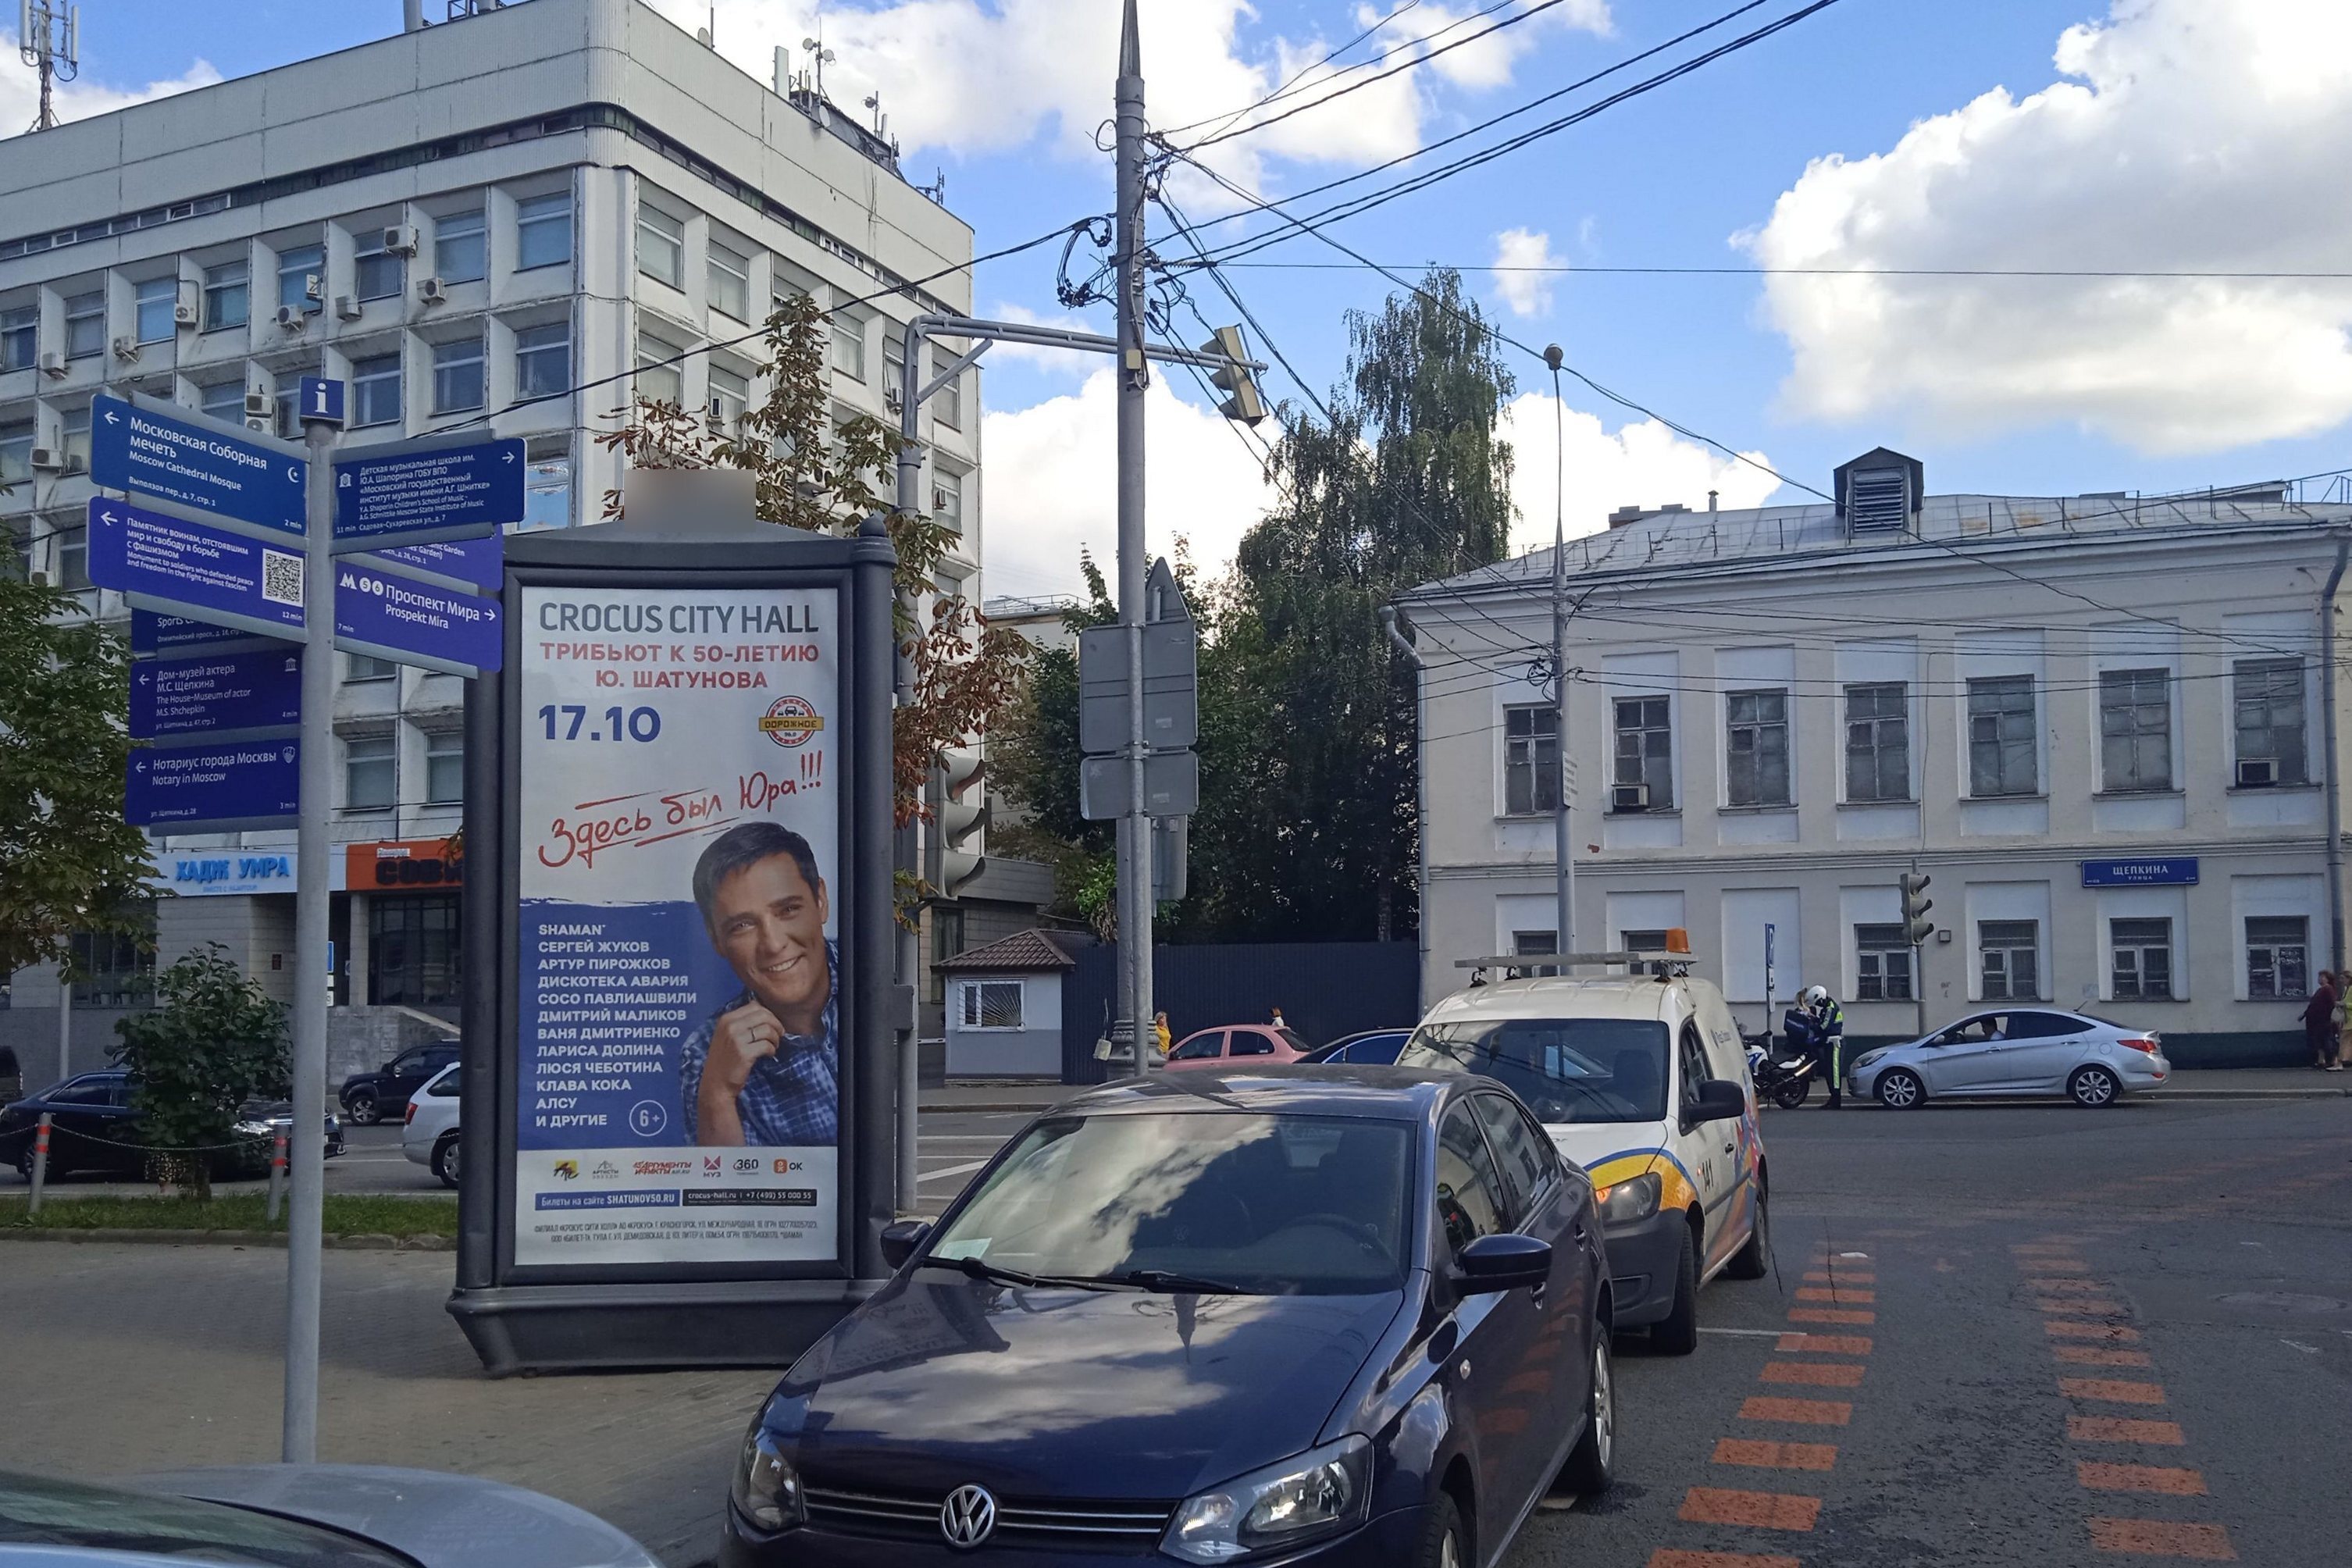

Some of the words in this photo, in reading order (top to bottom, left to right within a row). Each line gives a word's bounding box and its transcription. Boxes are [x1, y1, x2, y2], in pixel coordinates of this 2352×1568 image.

[130, 416, 206, 451] Московская
[209, 442, 266, 469] Соборная
[130, 435, 176, 458] мечеть
[129, 450, 164, 468] Moscow
[166, 461, 208, 480] Cathedral
[209, 473, 241, 490] Mosque
[359, 465, 387, 476] Детская
[389, 459, 436, 472] музыкальная
[437, 455, 461, 465] школа
[359, 476, 374, 484] Ю.А.
[376, 472, 413, 483] Шапорина
[433, 465, 447, 475] ВПО
[360, 480, 406, 494] «Московский
[408, 472, 470, 489] государственный
[128, 476, 163, 491] Выползов
[165, 487, 181, 497] пер.,
[197, 496, 209, 504] стр.
[359, 494, 390, 503] институт
[391, 490, 419, 501] музыки
[419, 487, 444, 496] имени
[444, 484, 455, 493] А.Г.
[127, 517, 168, 534] Памятник
[169, 529, 201, 543] воинам,
[201, 537, 248, 554] отстоявшим
[127, 529, 144, 541] мир
[152, 536, 185, 551] свободу
[192, 543, 219, 558] борьбе
[133, 541, 179, 558] фашизмом
[419, 546, 442, 559] Garden)
[444, 544, 465, 556] Garden
[127, 551, 162, 565] Monument
[170, 561, 194, 572] soldiers
[208, 570, 236, 581] defended
[236, 577, 253, 586] peace
[140, 561, 166, 572] freedom
[186, 572, 201, 581] fight
[202, 576, 224, 586] against
[225, 580, 247, 591] fascism
[386, 584, 445, 611] Проспект
[447, 600, 479, 622] Мира
[386, 604, 426, 623] Prospekt
[428, 614, 448, 629] Mira
[540, 602, 662, 633] CROCUS
[669, 605, 734, 633] CITY
[742, 604, 818, 633] HALL
[540, 642, 662, 661] ТРИБЬЮТ
[670, 645, 685, 662] К
[693, 643, 818, 663] 50-ЛЕТИЮ
[156, 666, 204, 682] Дом-музей
[205, 665, 234, 675] актера
[596, 669, 624, 687] Ю.
[633, 671, 768, 688] ШАТУНОВА
[174, 679, 214, 692] Щепкина
[156, 696, 169, 704] The
[169, 692, 223, 703] House-Museum
[223, 689, 231, 698] of
[155, 707, 169, 716] M.S.
[170, 704, 205, 715] Shchepkin
[539, 705, 661, 742] 17.10
[764, 720, 817, 729] ДОРОЖНОЕ
[153, 757, 198, 771] Нотариус
[201, 755, 234, 768] города
[237, 752, 276, 763] Москвы
[152, 775, 180, 786] Notary
[182, 773, 190, 782] in
[191, 773, 226, 782] Moscow
[539, 809, 651, 868] Здесь
[661, 789, 722, 825] был
[739, 750, 823, 812] Юра!!!
[176, 860, 230, 883] ХАДЖ
[238, 857, 290, 878] УМРА
[2113, 865, 2168, 875] ЩЕПКИНА
[538, 939, 593, 952] СЕРГЕЙ
[597, 941, 649, 952] ЖУКОВ
[537, 959, 585, 969] АРТУР
[589, 958, 670, 969] ПИРОЖКОВ
[537, 976, 627, 989] ДИСКОТЕКА
[630, 975, 687, 986] АВАРИЯ
[538, 993, 580, 1004] СОСО
[584, 992, 696, 1003] ПАВЛИАШВИЛИ
[537, 1007, 610, 1023] ДМИТРИЙ
[615, 1010, 686, 1021] МАЛИКОВ
[537, 1028, 576, 1039] ВАНЯ
[580, 1027, 679, 1040] ДМИТРИЕНКО
[536, 1045, 598, 1057] ЛАРИСА
[601, 1044, 663, 1057] ДОЛИНА
[536, 1063, 580, 1074] ЛЮСЯ
[585, 1061, 662, 1073] ЧЕБОТИНА
[536, 1080, 587, 1091] КЛАВА
[591, 1079, 631, 1090] КОКА
[536, 1097, 577, 1109] АЛСУ
[536, 1115, 546, 1126] И
[550, 1114, 607, 1128] ДРУГИЕ
[640, 1110, 660, 1127] 6+
[737, 1159, 758, 1170] 360
[541, 1196, 570, 1206] Билеты
[583, 1196, 604, 1205] сайте
[607, 1193, 674, 1204] SHATUNOV50.RU
